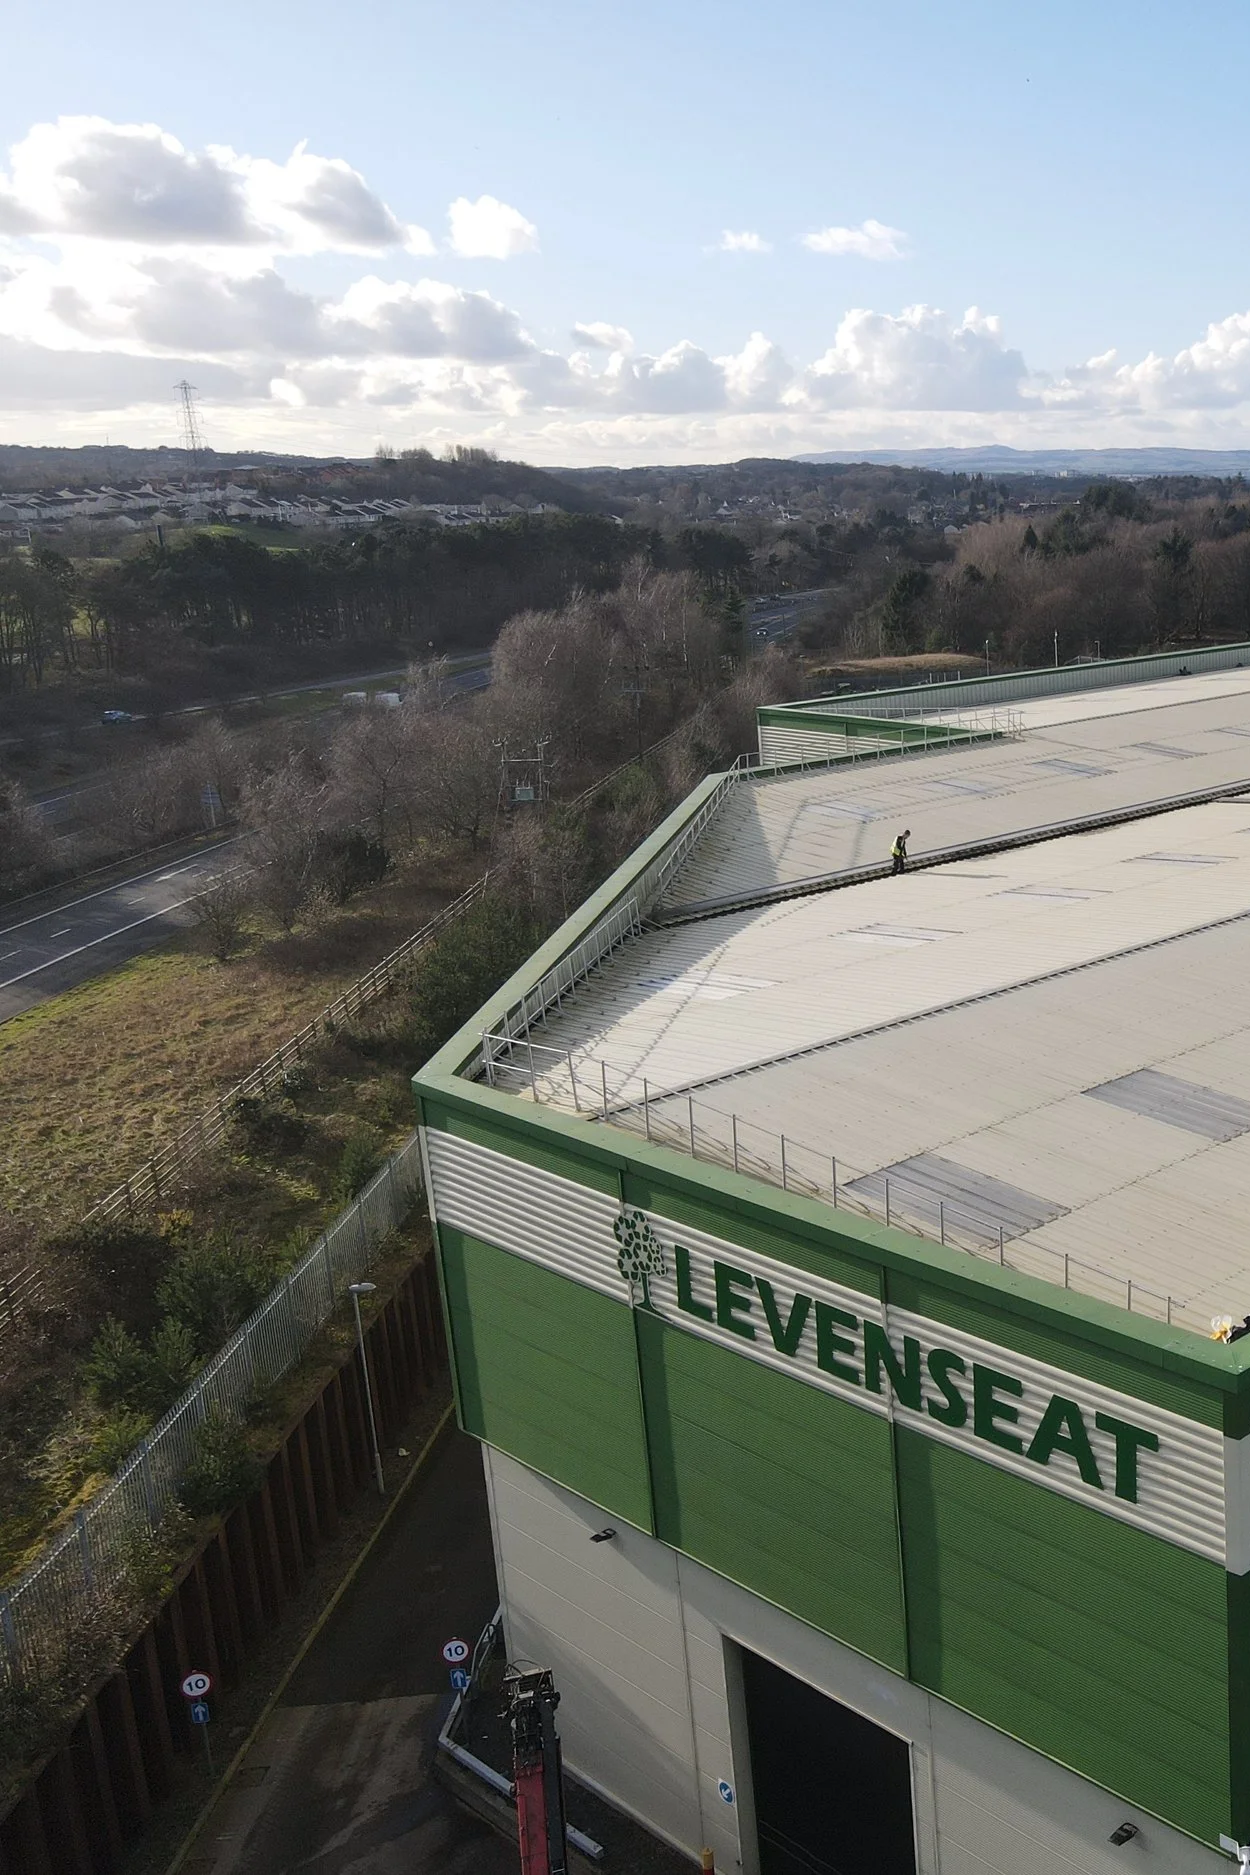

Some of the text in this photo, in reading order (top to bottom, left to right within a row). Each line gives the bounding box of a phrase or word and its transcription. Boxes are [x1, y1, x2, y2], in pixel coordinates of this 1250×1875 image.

[675, 1245, 1159, 1504] LEVENSEAT
[447, 1645, 464, 1657] 10
[187, 1679, 206, 1691] 10
